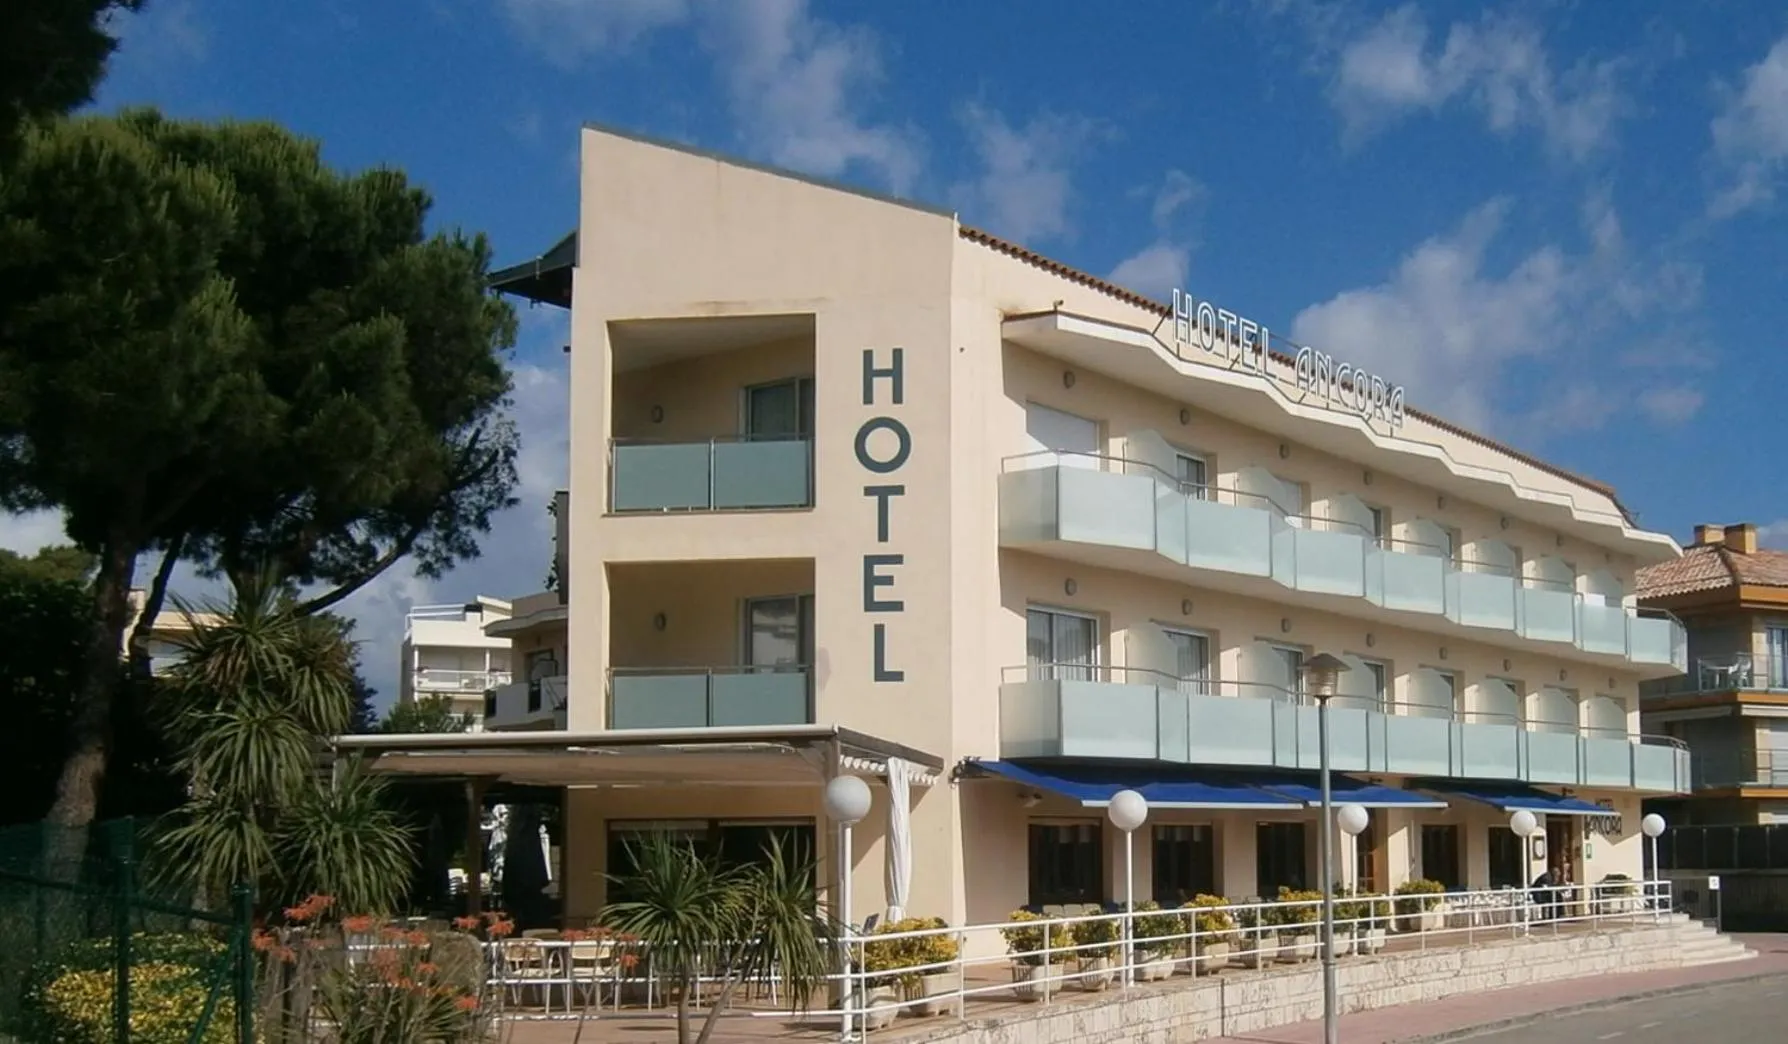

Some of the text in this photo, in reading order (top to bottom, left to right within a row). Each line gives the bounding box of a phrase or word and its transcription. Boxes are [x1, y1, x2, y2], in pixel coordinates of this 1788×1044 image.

[1173, 288, 1404, 429] HOTEL ANCORA
[854, 347, 912, 682] HOTEL
